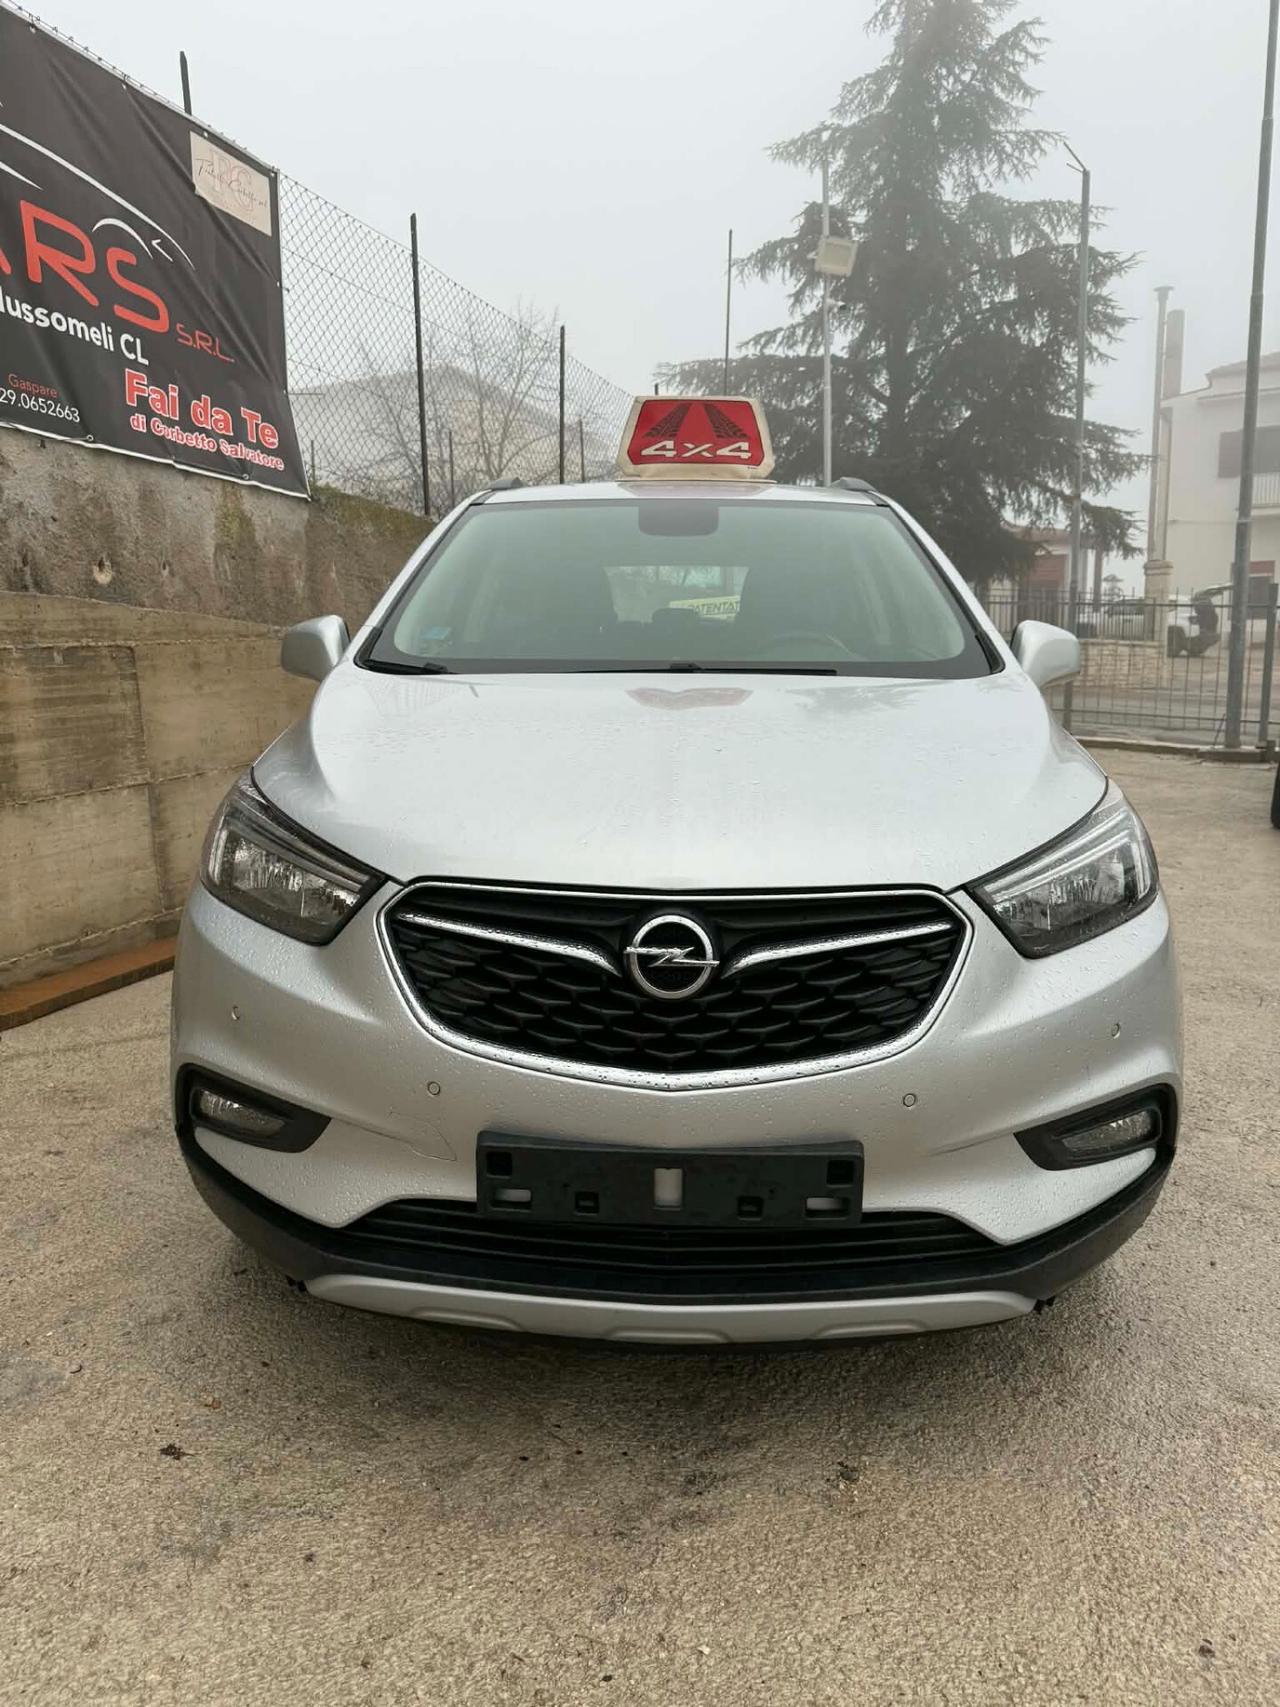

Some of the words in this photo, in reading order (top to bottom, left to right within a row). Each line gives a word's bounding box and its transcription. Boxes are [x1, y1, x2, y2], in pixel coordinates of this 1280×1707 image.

[120, 333, 149, 366] CL
[7, 373, 58, 398] Gaspare
[125, 368, 179, 420] Fai
[190, 394, 234, 436] da
[240, 406, 279, 449] Te
[130, 413, 146, 432] di
[219, 438, 285, 471] Salvatore
